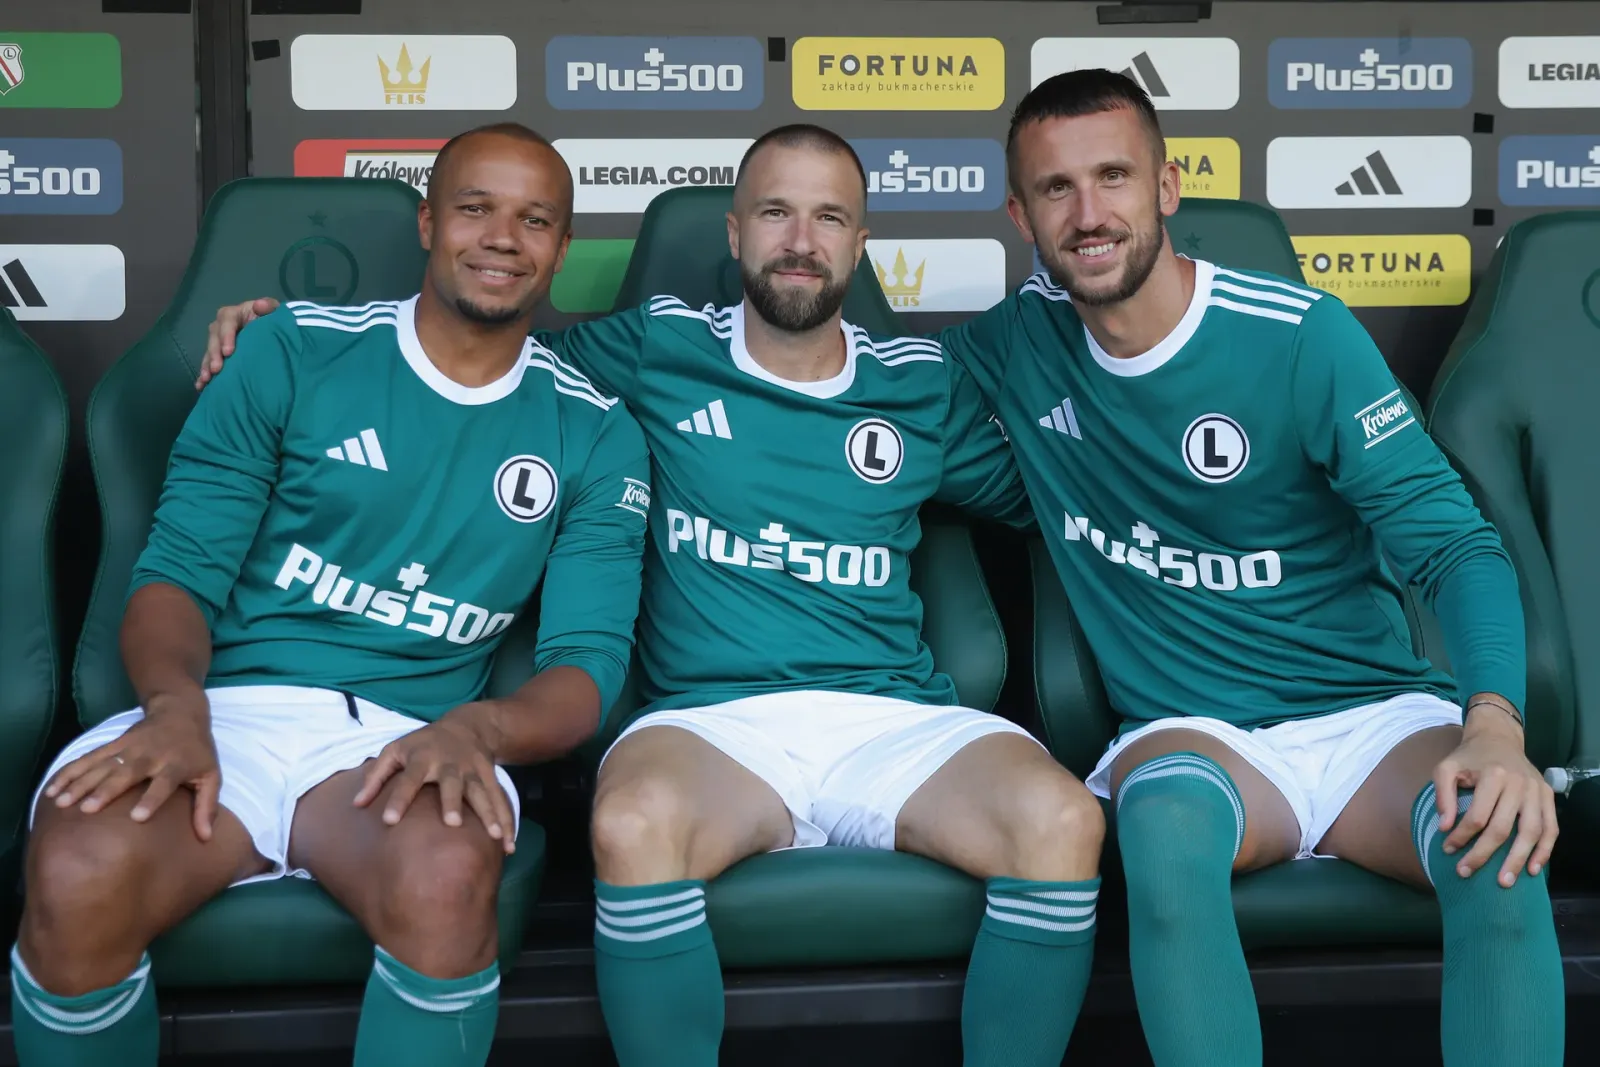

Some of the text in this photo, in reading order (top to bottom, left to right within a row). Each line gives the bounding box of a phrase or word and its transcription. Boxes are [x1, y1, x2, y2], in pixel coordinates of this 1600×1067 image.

[567, 61, 743, 92] Plus500
[818, 54, 979, 76] FORTUNA
[1287, 62, 1453, 91] Plus500
[1528, 63, 1600, 81] LEGIA
[385, 94, 426, 105] FLIS
[822, 82, 975, 93] zakłady bukmacherskie
[579, 166, 734, 186] LEGIA.COM
[303, 250, 337, 297] L
[886, 296, 920, 307] LIS
[863, 430, 886, 472] L
[1204, 427, 1229, 468] L
[511, 467, 536, 511] L
[666, 508, 891, 587] Plus500
